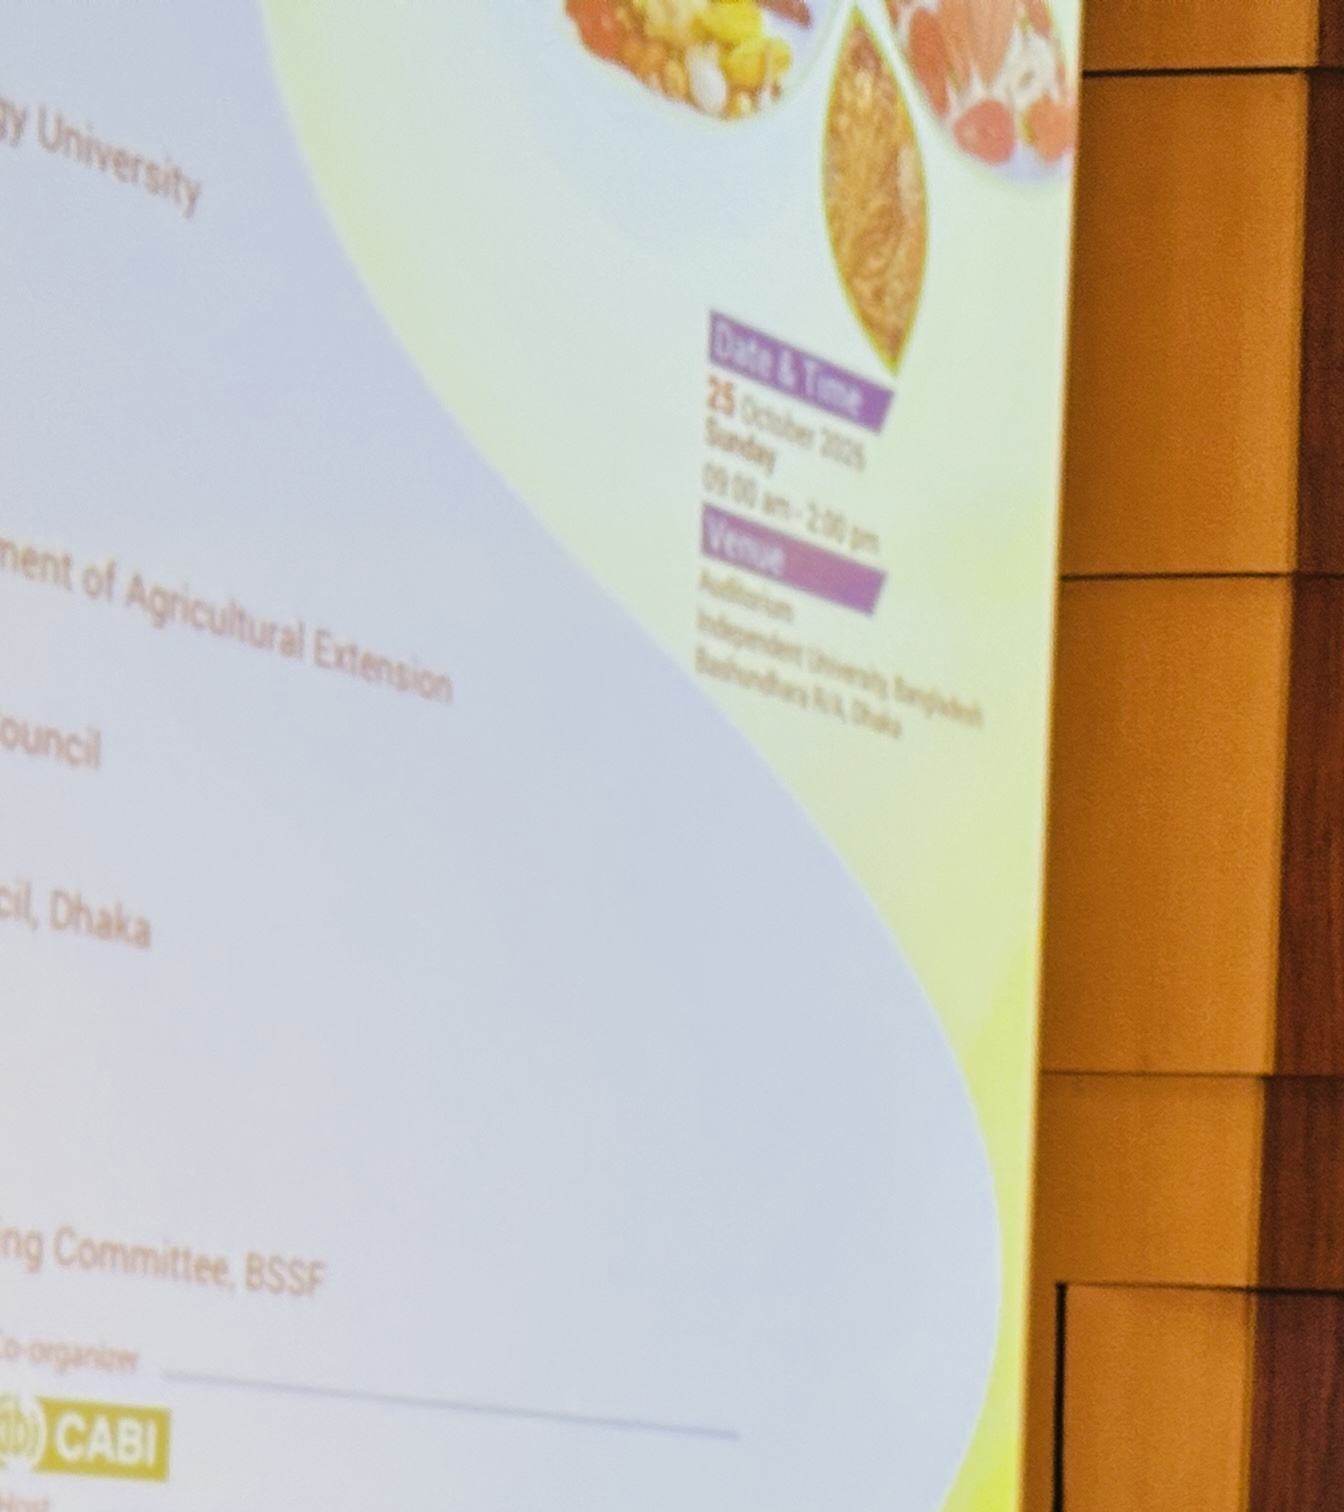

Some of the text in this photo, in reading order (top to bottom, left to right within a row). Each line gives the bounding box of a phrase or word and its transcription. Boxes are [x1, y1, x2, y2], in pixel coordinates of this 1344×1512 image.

[37, 106, 201, 218] University
[713, 318, 863, 419] Date & Time
[705, 416, 775, 475] Sunday
[707, 514, 784, 573] Venue
[83, 558, 121, 600] of
[125, 572, 306, 664] Agricultural
[313, 629, 454, 705] Extension
[49, 888, 153, 951] Dhaka
[54, 1226, 238, 1293] Committee,
[245, 1251, 328, 1298] BSSF
[55, 1411, 158, 1468] CABI
